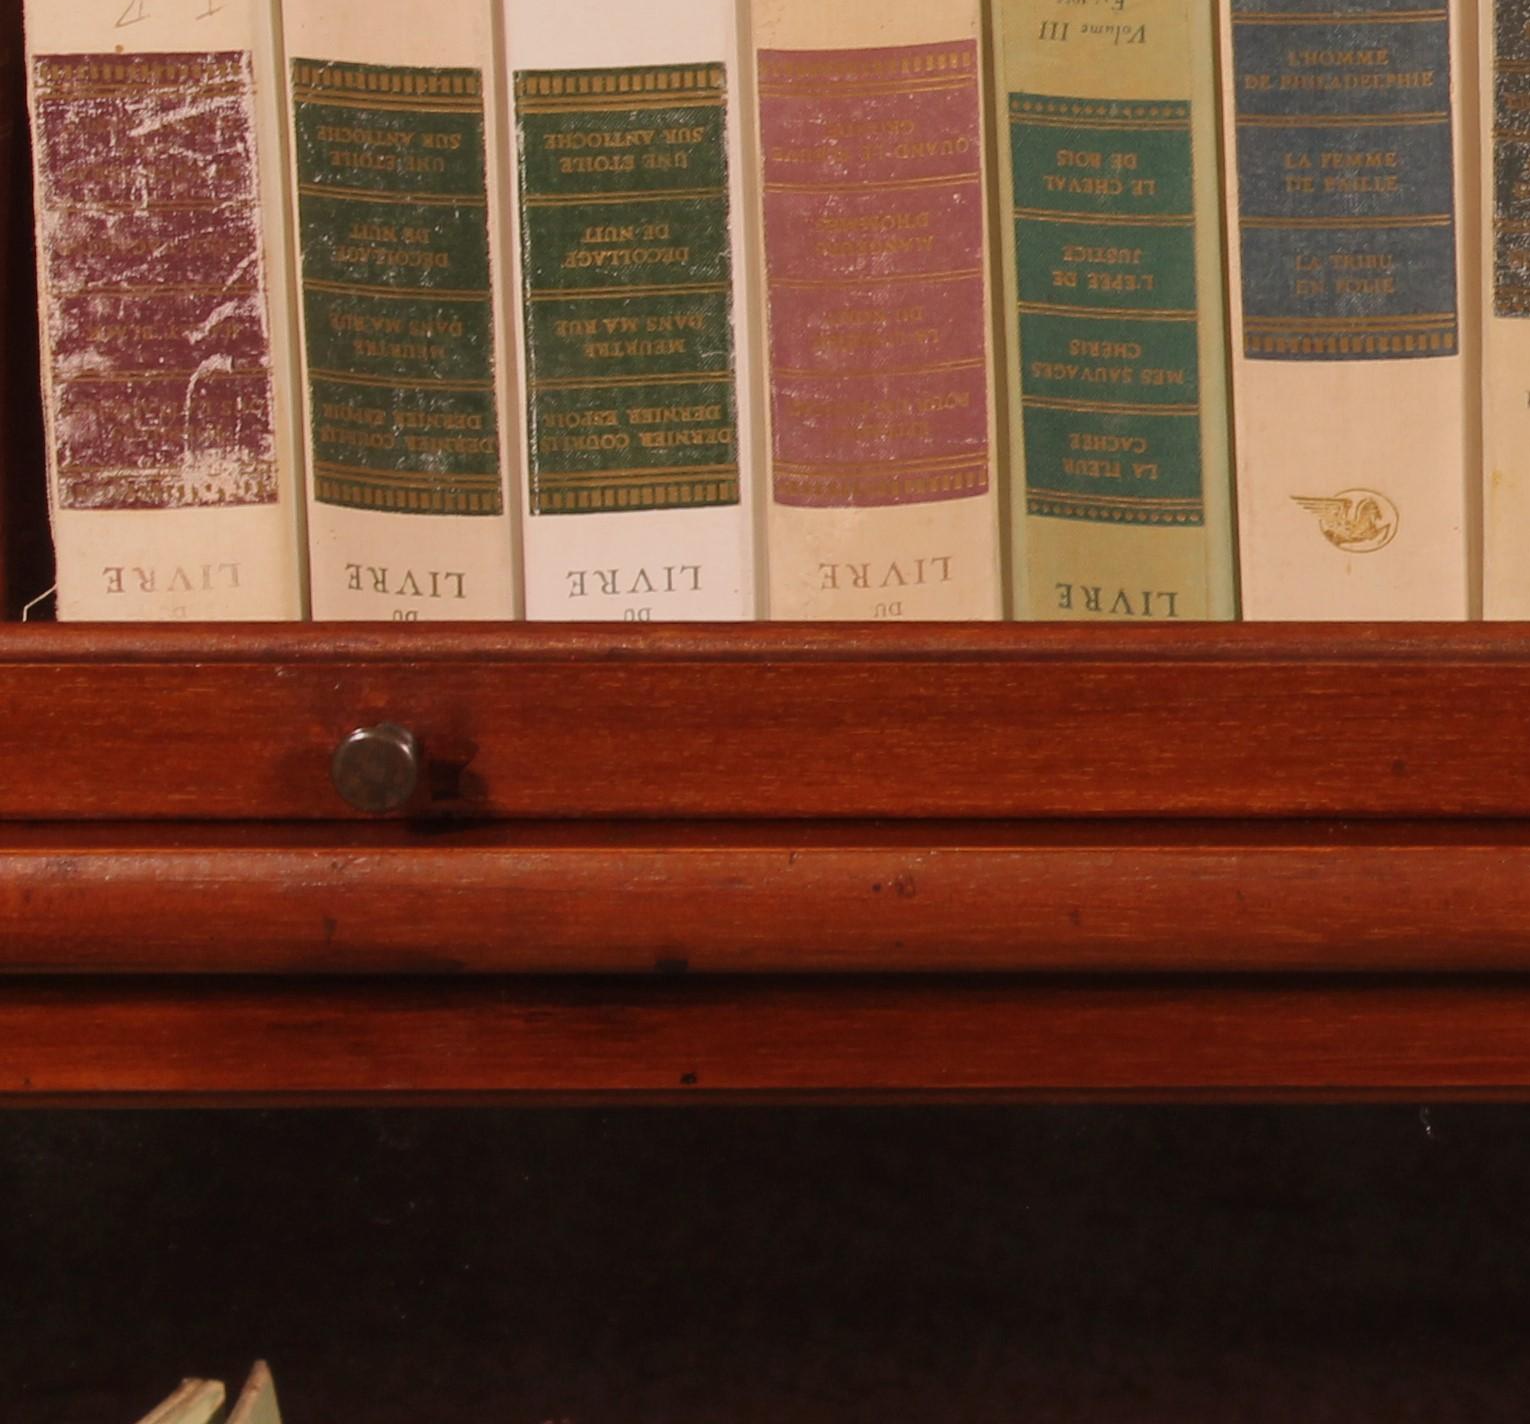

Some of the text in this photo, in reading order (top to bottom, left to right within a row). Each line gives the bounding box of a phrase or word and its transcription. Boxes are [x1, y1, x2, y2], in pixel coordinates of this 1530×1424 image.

[1038, 20, 1149, 45] Volume III
[317, 126, 417, 147] ANTIOCHE
[543, 126, 705, 150] SUR ANTIOCHE
[558, 151, 689, 174] UNE ETOILE
[1056, 148, 1137, 170] DE BOIS
[1283, 151, 1398, 169] LA FEMME
[1042, 174, 1156, 196] LE CHEVAL
[581, 224, 671, 244] DE NUIT
[1061, 245, 1143, 265] JUSTICE
[1051, 271, 1078, 288] DE
[554, 312, 705, 337] DANS MA RUE
[583, 339, 686, 359] MEURTRE
[1030, 361, 1185, 386] MES SAUVAGES
[541, 405, 721, 428] DERNIER ESPOIR
[638, 428, 733, 448] DERNIER
[1061, 458, 1159, 480] LA FLEUR
[102, 563, 241, 594] LIVRE
[344, 563, 467, 599] LIVRE
[565, 565, 702, 599] LIVRE
[817, 556, 953, 590] LIVRE
[872, 601, 903, 618] DU
[1054, 582, 1179, 618] LIVRE
[622, 607, 653, 623] DU
